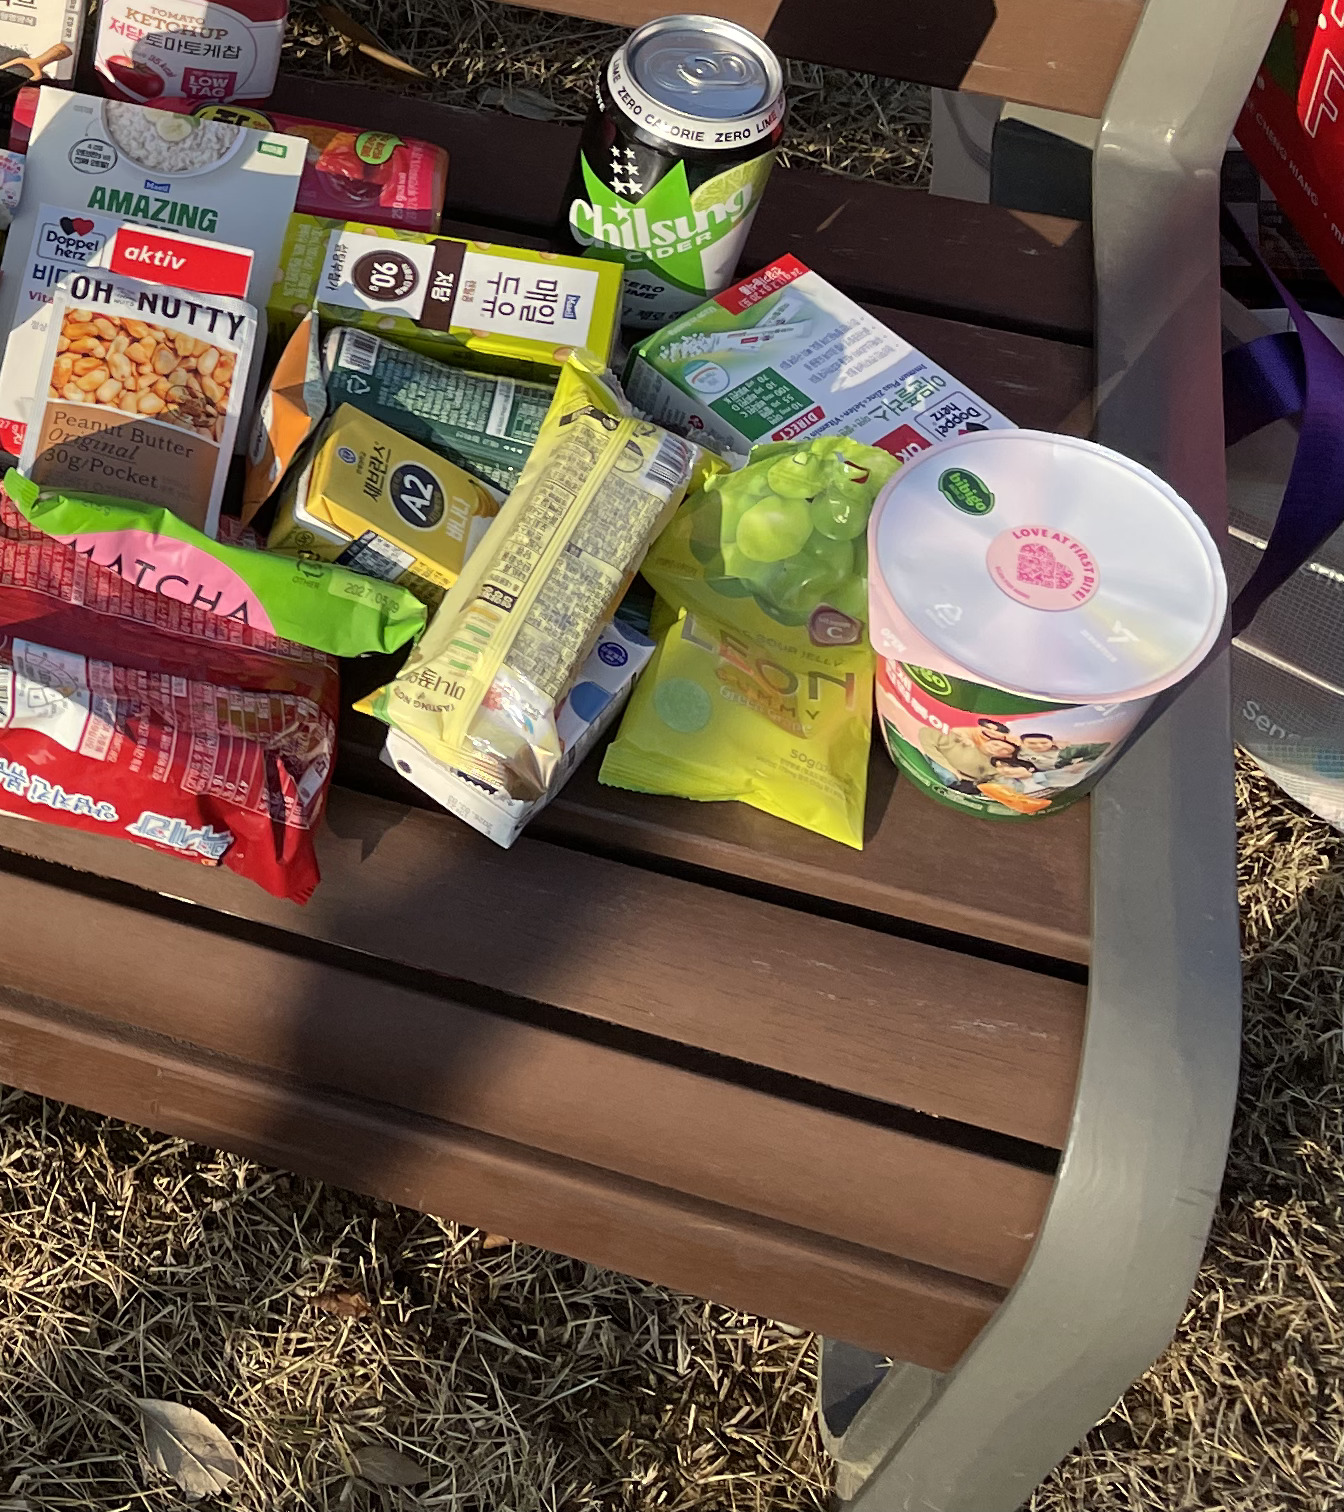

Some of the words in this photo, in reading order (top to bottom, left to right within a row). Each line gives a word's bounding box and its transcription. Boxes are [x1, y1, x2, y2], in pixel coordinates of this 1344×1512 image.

[125, 7, 228, 41] KETCHUP
[151, 6, 206, 25] TOMATO
[189, 74, 230, 90] LOW
[193, 86, 226, 98] TAG
[617, 85, 642, 115] ZERO
[645, 113, 705, 142] CALORIE
[714, 128, 751, 142] ZERO
[756, 112, 779, 134] LIME
[87, 185, 220, 234] AMAZING
[569, 182, 753, 250] Chilsung
[46, 230, 100, 253] Doppel
[54, 245, 86, 261] herz
[625, 230, 713, 263] CIDER
[124, 245, 187, 271] aktiv
[372, 260, 399, 292] 9.0
[432, 270, 456, 302] 저당
[29, 289, 55, 305] Vita
[71, 275, 111, 306] OH
[137, 291, 247, 342] NUTTY
[482, 272, 521, 319] 두유
[519, 279, 559, 326] 매일
[624, 289, 659, 301] IME
[776, 410, 824, 442] DIRECT
[931, 400, 965, 423] herz
[48, 427, 140, 461] Original
[53, 411, 124, 438] Peanut
[129, 429, 194, 458] Butter
[44, 448, 159, 489] 30g/Pocket
[400, 473, 434, 522] A2
[949, 472, 988, 512] bibigo
[1012, 527, 1048, 540] LOVE
[1051, 532, 1070, 545] AT
[1069, 542, 1095, 575] FIRST
[1072, 575, 1095, 602] BITE!
